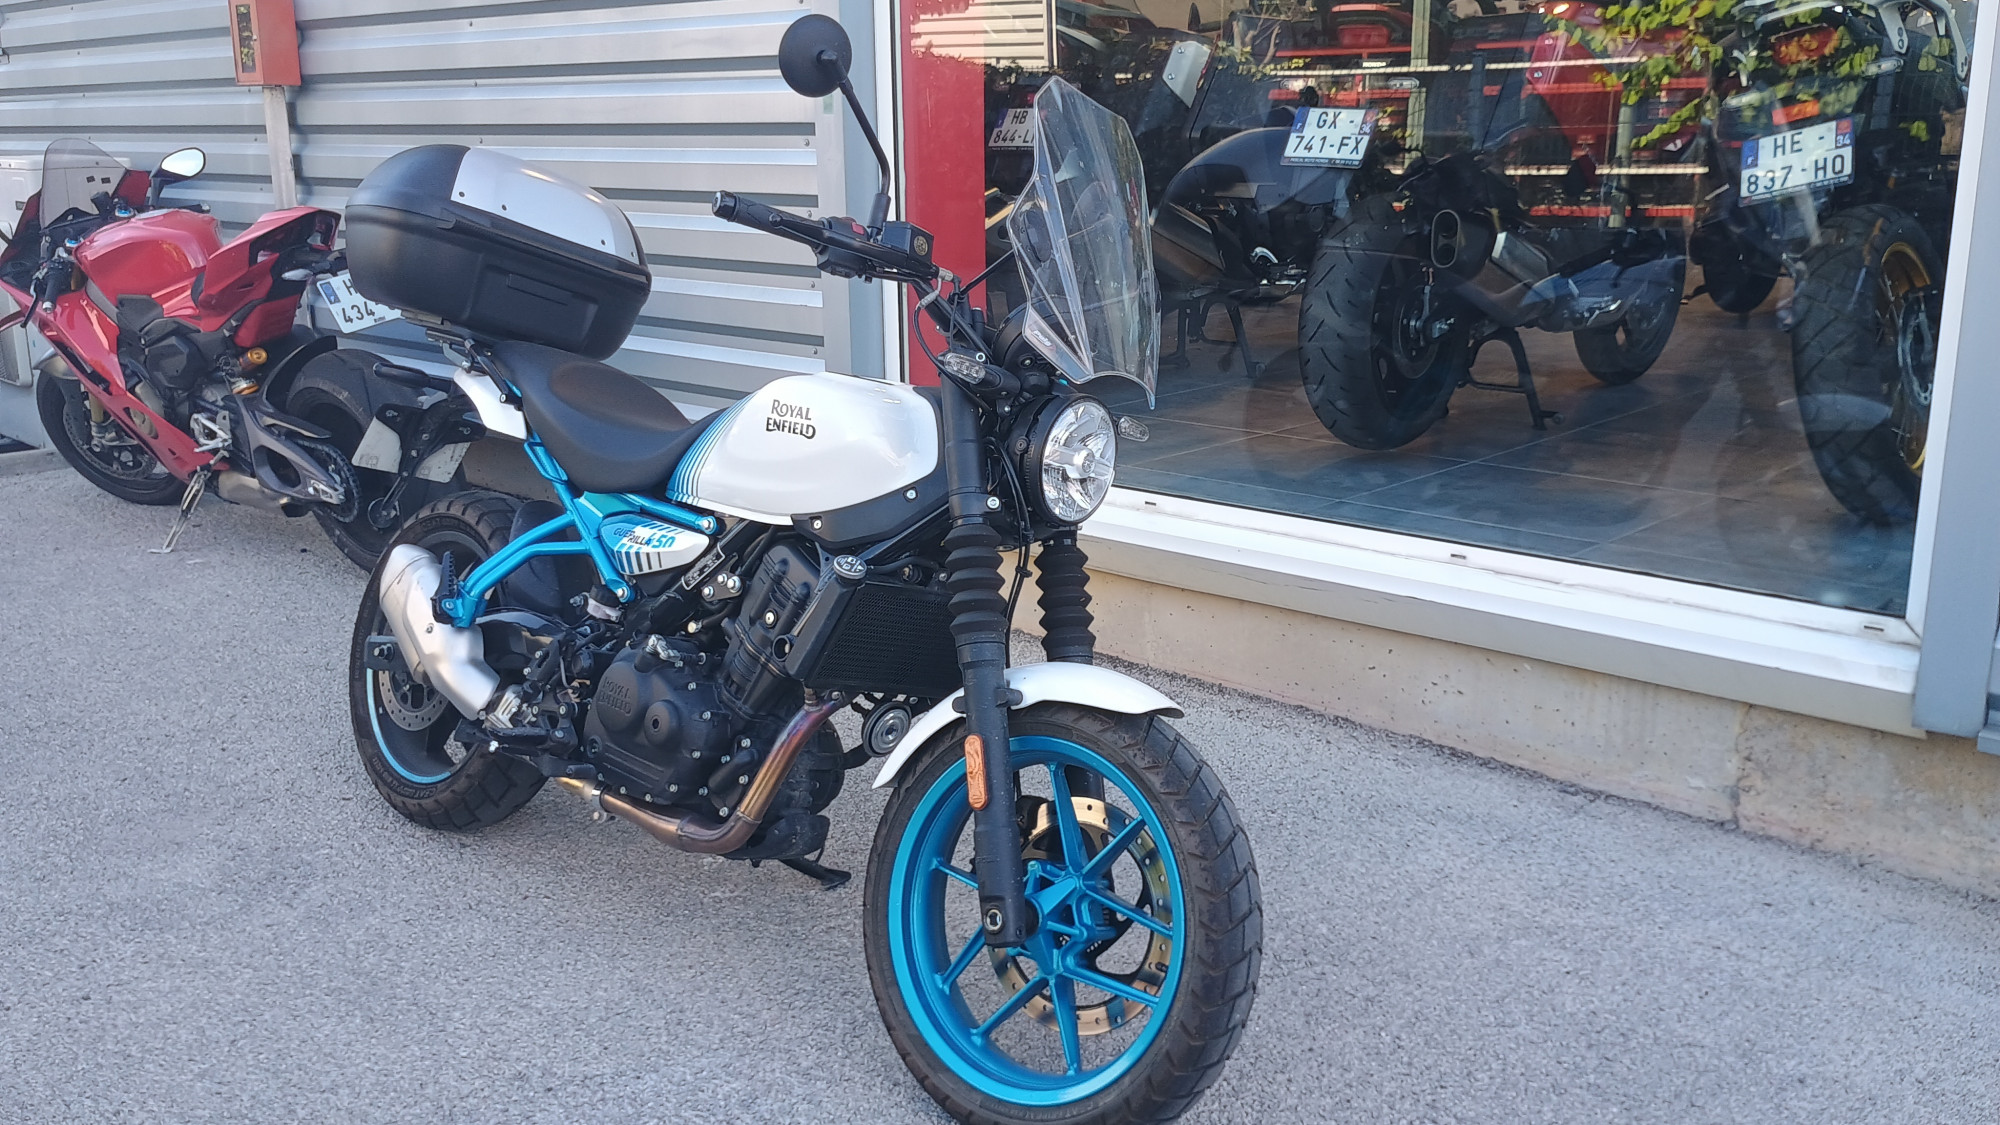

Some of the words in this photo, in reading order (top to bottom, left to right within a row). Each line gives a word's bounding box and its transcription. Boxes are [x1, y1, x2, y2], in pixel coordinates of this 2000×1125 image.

[1011, 110, 1029, 125] HB
[1316, 111, 1342, 129] GX
[1292, 135, 1364, 155] 741-FX
[1773, 131, 1803, 158] HE
[771, 399, 812, 420] ROYAL
[766, 417, 816, 439] ENFIELD
